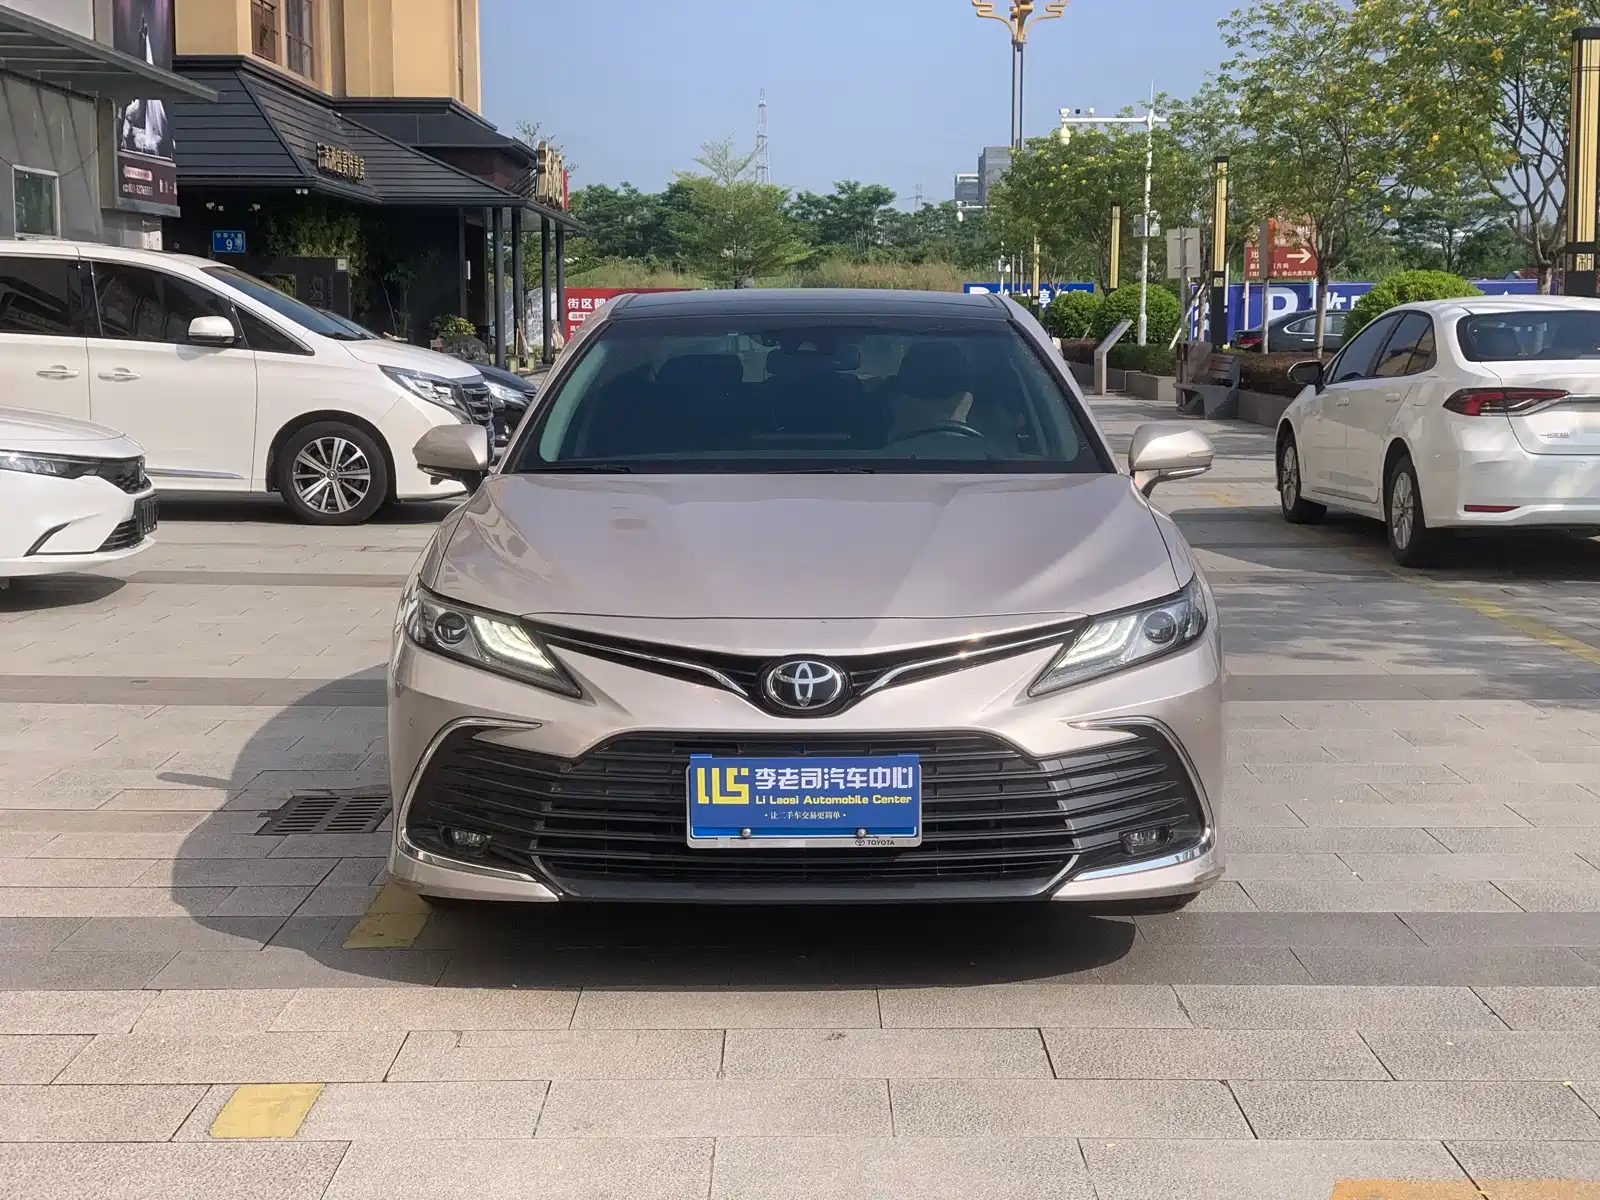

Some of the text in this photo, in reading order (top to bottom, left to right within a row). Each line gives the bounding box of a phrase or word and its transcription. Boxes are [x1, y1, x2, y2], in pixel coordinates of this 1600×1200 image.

[755, 767, 913, 790] 李老司汽车中心
[756, 794, 912, 805] Li Laosi Automobile Center
